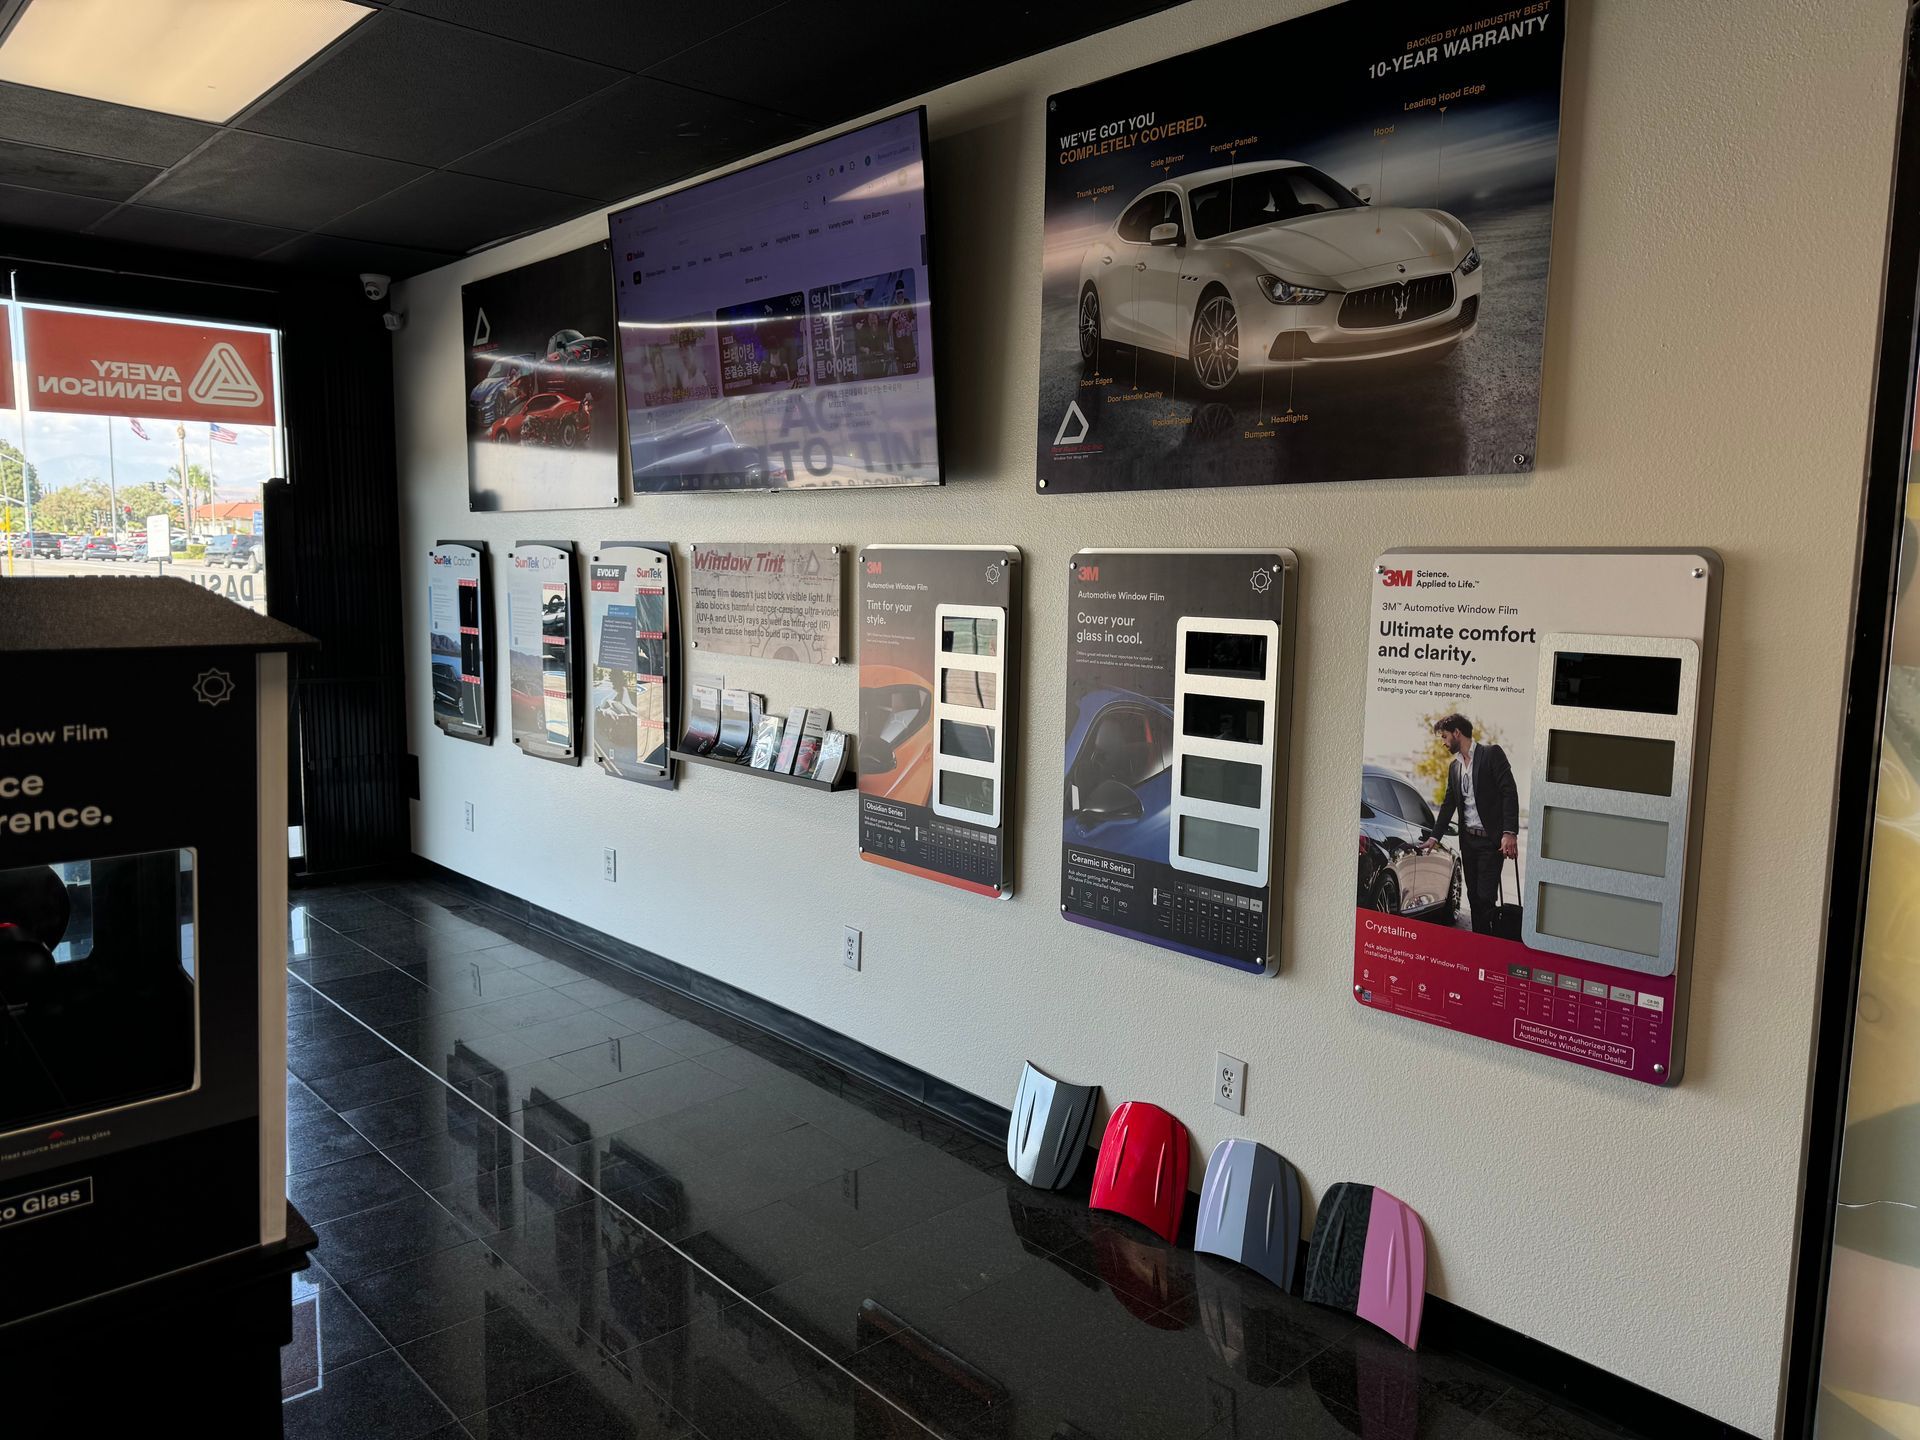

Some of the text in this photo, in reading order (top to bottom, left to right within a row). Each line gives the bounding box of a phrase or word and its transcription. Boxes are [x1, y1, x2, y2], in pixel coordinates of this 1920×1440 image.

[1407, 0, 1551, 50] BACKED BY AN INDUSTRY BEST
[1369, 14, 1550, 79] 10-YEAR WARRANTY
[1404, 84, 1486, 111] Leading Hood Edge
[1060, 112, 1155, 149] WE'VE GOT YOU
[1373, 124, 1396, 137] Hood
[1059, 115, 1208, 165] COMPLETELY COVERED.
[1210, 135, 1258, 153] Fender Panels
[1150, 153, 1185, 169] Side Mirror
[1076, 188, 1093, 199] Trunk
[1080, 376, 1113, 387] Door Edges
[1107, 390, 1163, 402] Door Handle Cavity
[1271, 413, 1309, 424] Headlights
[1244, 429, 1275, 440] Bumpers
[434, 555, 452, 565] SunTek
[515, 557, 539, 569] SunTek
[695, 550, 785, 573] Window Tint
[867, 561, 882, 574] 3M
[597, 568, 620, 577] EVOLVE
[636, 567, 662, 578] SunTek
[1078, 566, 1099, 581] 3M
[1382, 569, 1449, 587] 3M Science.
[866, 581, 928, 591] Automotive Window Film
[1416, 580, 1446, 589] Applied
[695, 587, 825, 604] Tinting film doesn't just block visible light.
[1078, 590, 1165, 601] Automotive Window Film
[696, 601, 708, 609] also
[710, 602, 730, 611] blocks
[756, 605, 803, 617] cancer-causing
[805, 606, 839, 617] ultra-violet
[867, 600, 912, 614] Tint for your
[1403, 603, 1455, 613] Automotive
[1457, 605, 1496, 615] Window
[1498, 606, 1518, 615] Film
[715, 614, 727, 622] and
[746, 617, 760, 626] rays
[761, 618, 768, 626] as
[769, 617, 781, 626] well
[867, 614, 887, 626] style.
[1077, 612, 1136, 629] Cover your
[697, 626, 824, 642] rays that cause heat build up your car.
[1077, 629, 1143, 644] glass in cool.
[1380, 621, 1536, 644] Ultimate comfort
[1378, 643, 1476, 665] and clarity.
[1378, 668, 1407, 677] Multilayer
[1408, 670, 1428, 678] optical
[1442, 673, 1495, 683] nano-technology
[1377, 686, 1404, 694] changing
[1434, 690, 1472, 699] appearance.
[1378, 677, 1397, 685] rejects
[1483, 684, 1498, 692] films
[1500, 686, 1525, 694] without
[63, 723, 108, 742] Film
[866, 801, 904, 818] Obsidian Series
[1071, 853, 1131, 875] Ceramic IR Series
[1365, 919, 1417, 940] Crystalline
[1364, 941, 1470, 972] Ask about getting Window Film
[1364, 949, 1406, 964] installed today.
[1520, 1023, 1606, 1052] Installed by an Authorized
[1519, 1032, 1627, 1066] Automotive Window Film Dealer
[0, 1130, 111, 1161] Heat source behind the glass
[22, 1188, 81, 1214] Glass
